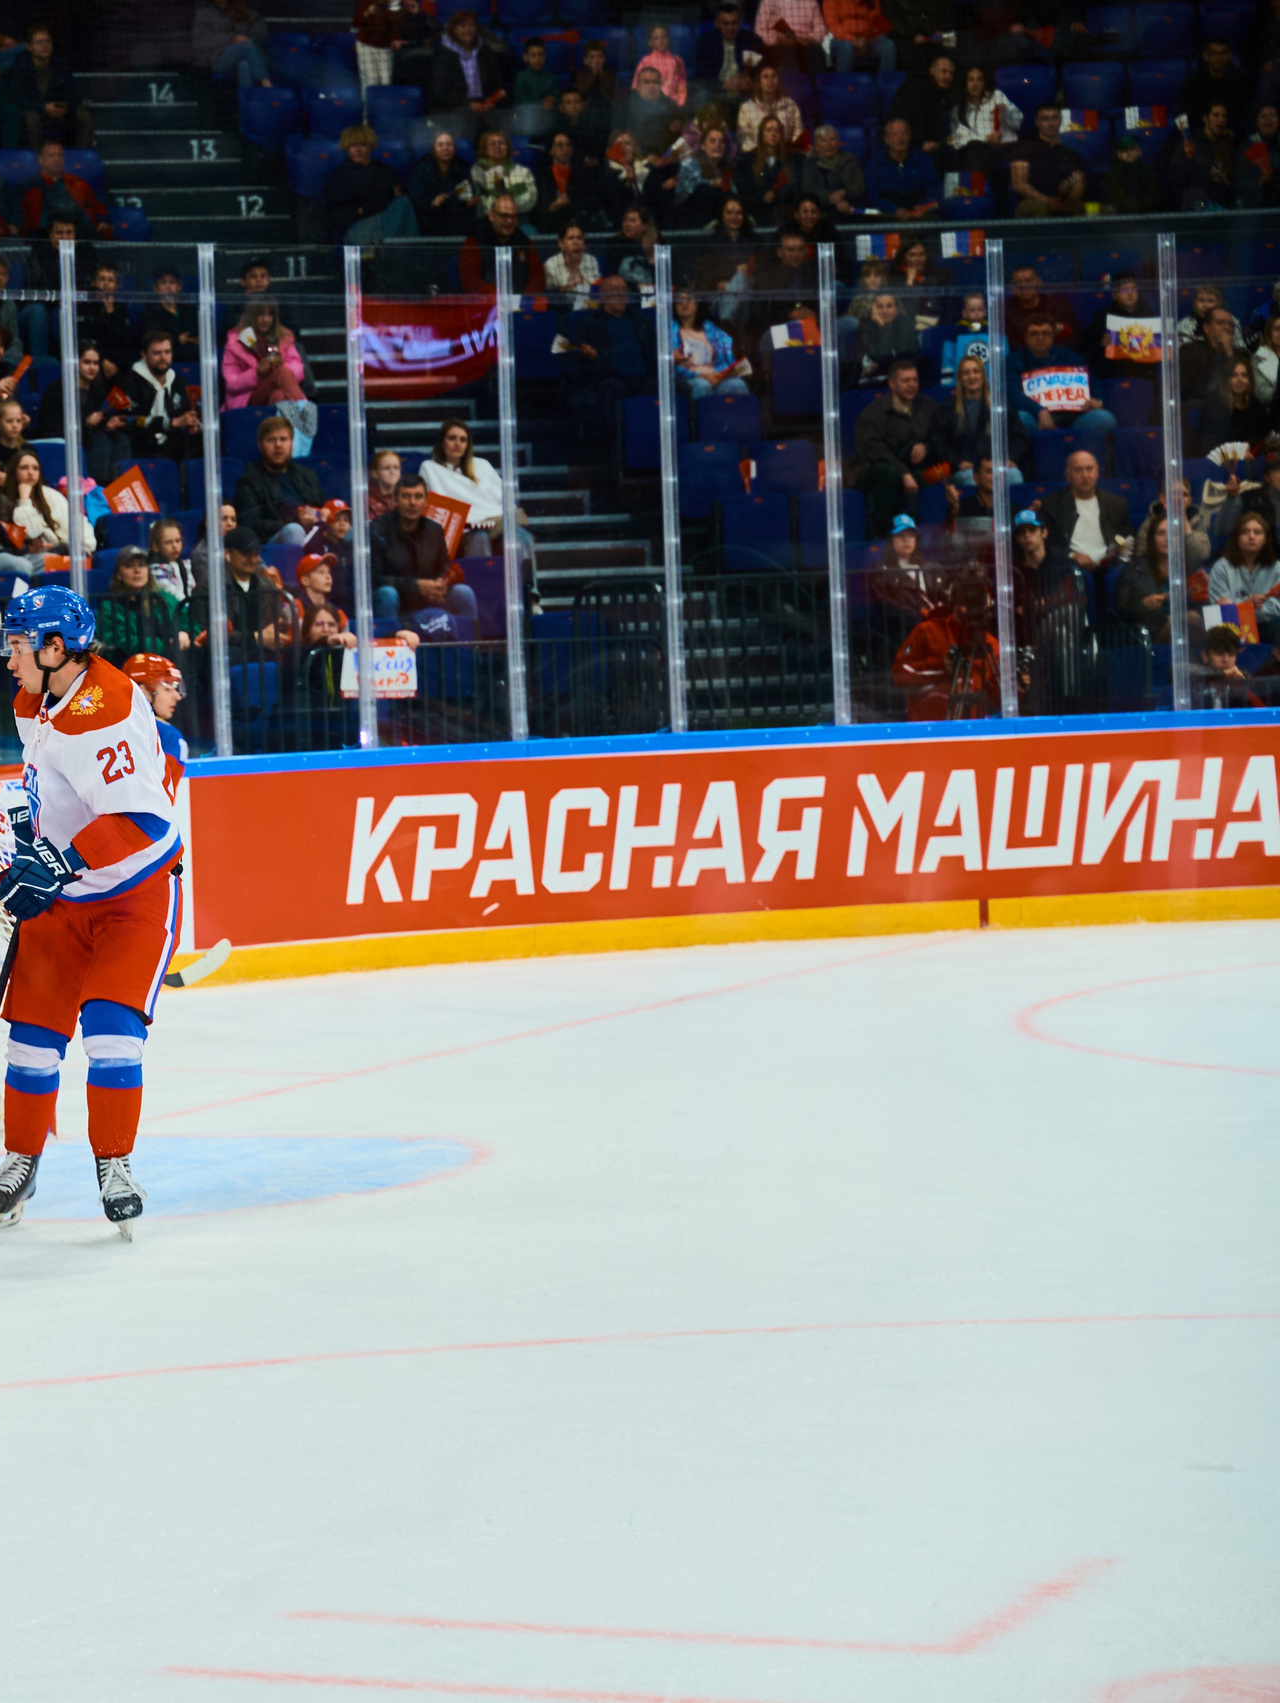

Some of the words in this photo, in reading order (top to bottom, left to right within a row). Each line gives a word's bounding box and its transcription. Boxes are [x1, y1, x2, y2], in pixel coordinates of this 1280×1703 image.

[148, 82, 174, 105] 14
[189, 138, 217, 161] 13
[237, 194, 265, 218] 12
[286, 256, 307, 280] 11
[96, 739, 136, 785] 23
[346, 774, 827, 905] КРАСНАЯ
[846, 754, 1280, 878] МАШИНА
